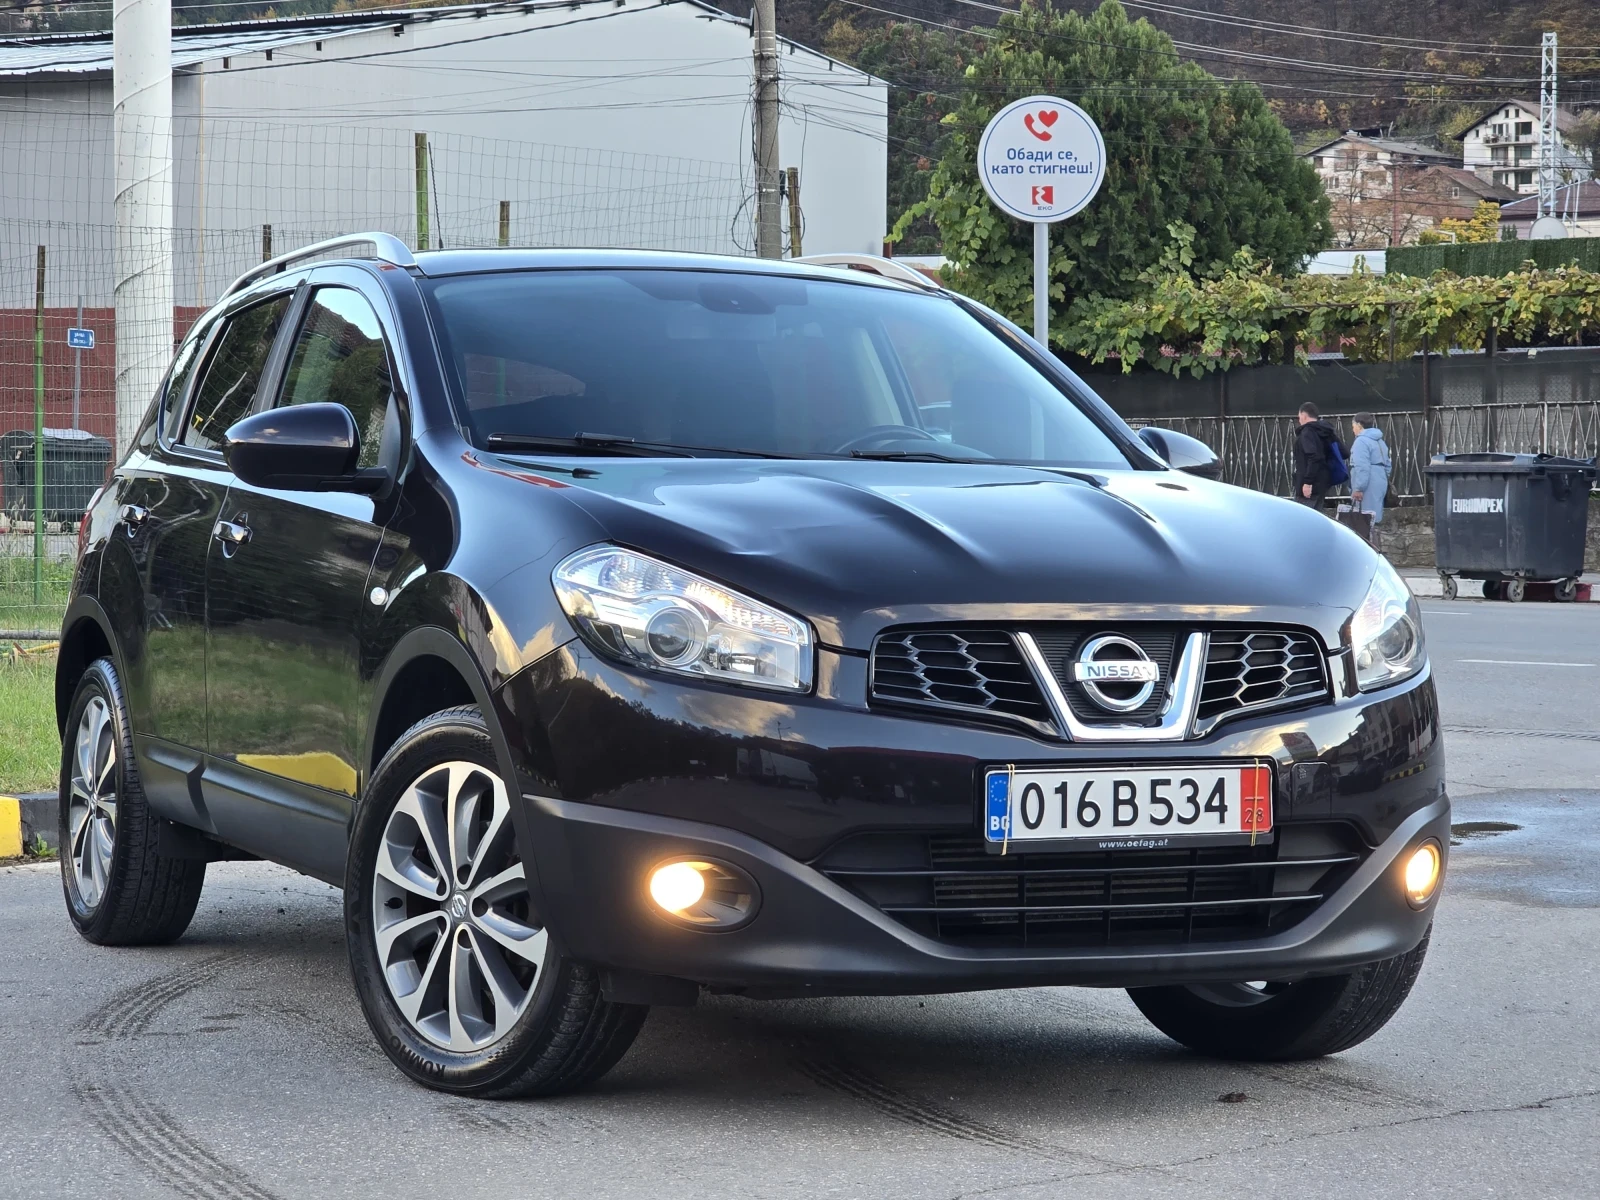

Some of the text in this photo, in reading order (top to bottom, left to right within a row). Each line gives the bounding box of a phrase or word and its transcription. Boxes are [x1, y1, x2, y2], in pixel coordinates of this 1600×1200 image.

[1007, 148, 1078, 162] Обади се,
[992, 162, 1093, 175] като стигнеш!
[1452, 498, 1504, 513] EUROIMPEX
[1087, 665, 1153, 677] NISSAN
[990, 815, 1010, 831] BG
[1098, 838, 1169, 849] www.oefag.at
[389, 1035, 446, 1078] KUMHO
